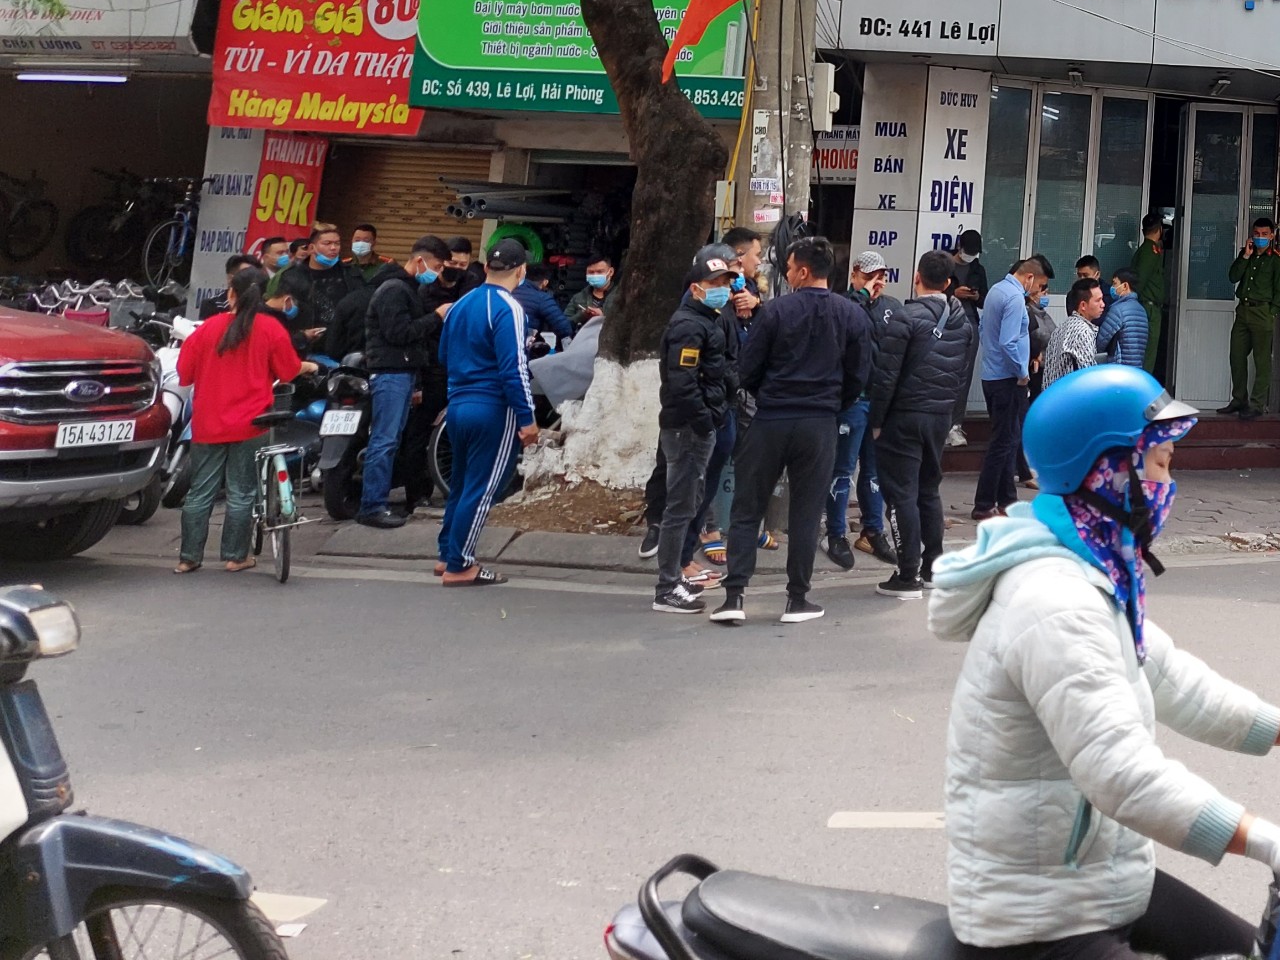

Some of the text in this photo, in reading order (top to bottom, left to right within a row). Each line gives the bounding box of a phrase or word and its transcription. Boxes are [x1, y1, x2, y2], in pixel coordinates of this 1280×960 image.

[474, 0, 581, 18] Đại lý máy bơm nước
[482, 21, 583, 39] Giới thiệu sản phẩm
[859, 16, 996, 44] ĐC: 441 Lê Lợi
[481, 40, 507, 55] Thiết
[510, 41, 520, 58] bị
[522, 42, 553, 59] ngành
[556, 42, 582, 58] nước
[224, 41, 414, 84] TÚI VÍ DA THẬT
[422, 79, 443, 96] ĐC:
[446, 76, 463, 97] Số
[466, 82, 492, 100] 439,
[496, 81, 512, 99] Lê
[516, 83, 537, 103] Lợi,
[541, 82, 562, 101] Hải
[565, 83, 605, 105] Phòng
[940, 90, 978, 108] ĐỨC HUY
[228, 88, 410, 129] Hàng Malaysia
[875, 121, 907, 138] MUA
[944, 127, 968, 160] XE
[873, 154, 904, 173] BÁN
[255, 173, 314, 227] 99k
[878, 194, 896, 210] XE
[930, 175, 974, 218] ĐIỆN
[869, 230, 898, 249] ĐẠP
[62, 421, 133, 445] 15A-431.22
